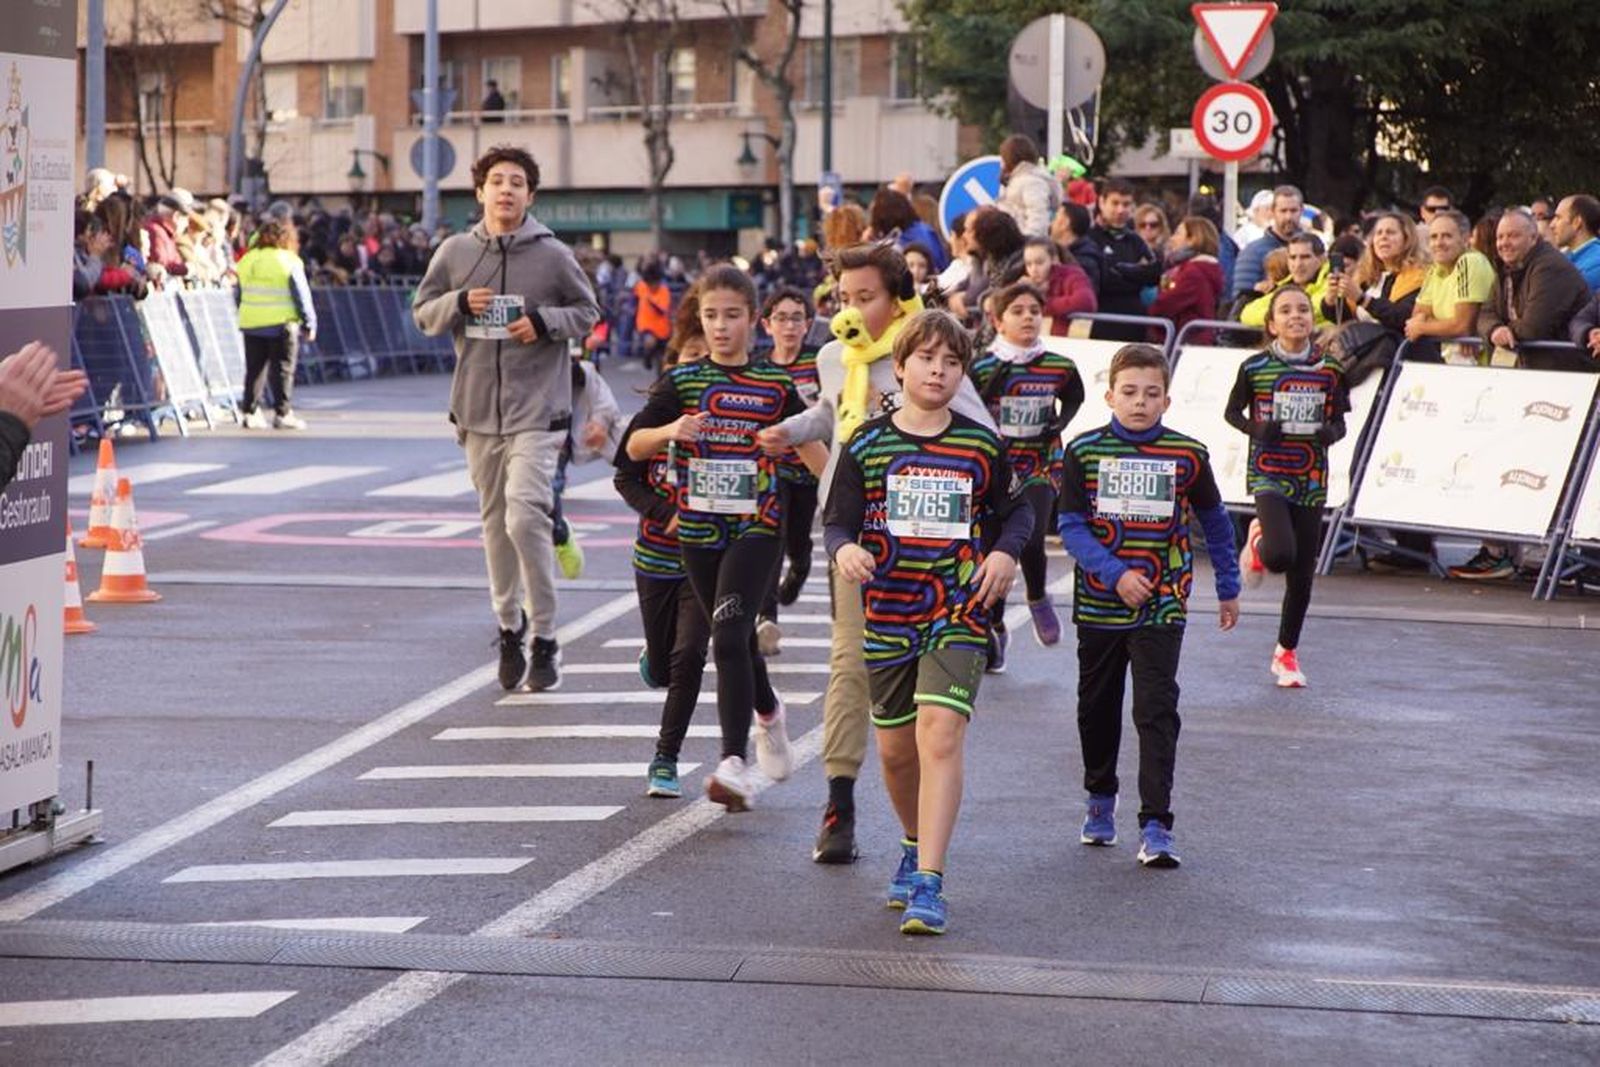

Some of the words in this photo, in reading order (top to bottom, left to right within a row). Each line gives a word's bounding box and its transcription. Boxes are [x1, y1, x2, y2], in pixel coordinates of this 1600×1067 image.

[1212, 110, 1252, 135] 30
[474, 306, 508, 325] 581
[1281, 403, 1316, 421] 5782
[11, 441, 53, 482] UNDAI
[706, 462, 752, 472] SETEL
[1120, 461, 1169, 472] SETEL
[696, 473, 741, 496] 5852
[909, 479, 963, 491] SETEL
[1107, 472, 1158, 496] 5880
[897, 491, 951, 518] 5765
